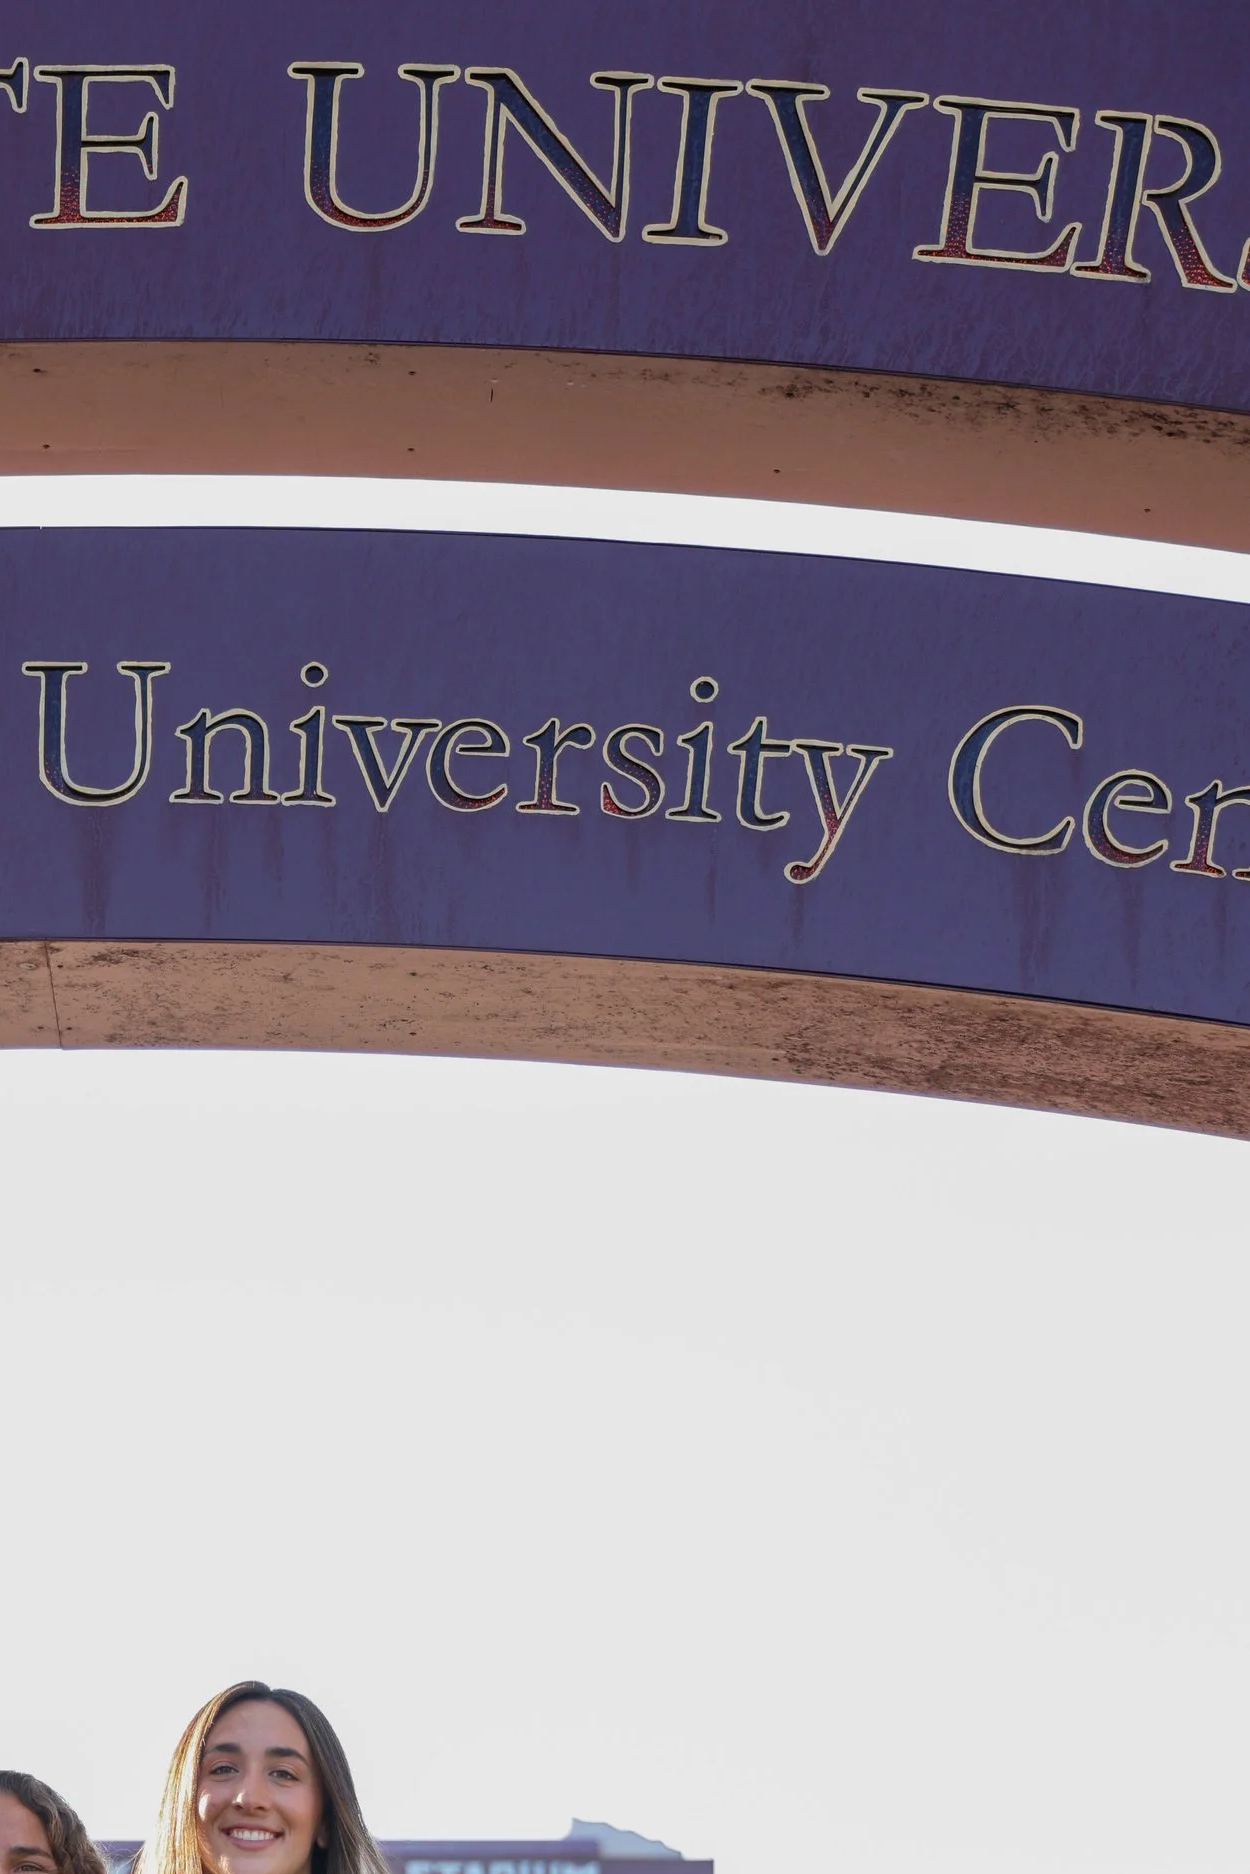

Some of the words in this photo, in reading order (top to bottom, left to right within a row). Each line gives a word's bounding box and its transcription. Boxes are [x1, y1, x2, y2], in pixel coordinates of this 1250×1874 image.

[288, 60, 1250, 294] UNIVER
[21, 660, 894, 885] University
[948, 704, 1250, 881] Cen
